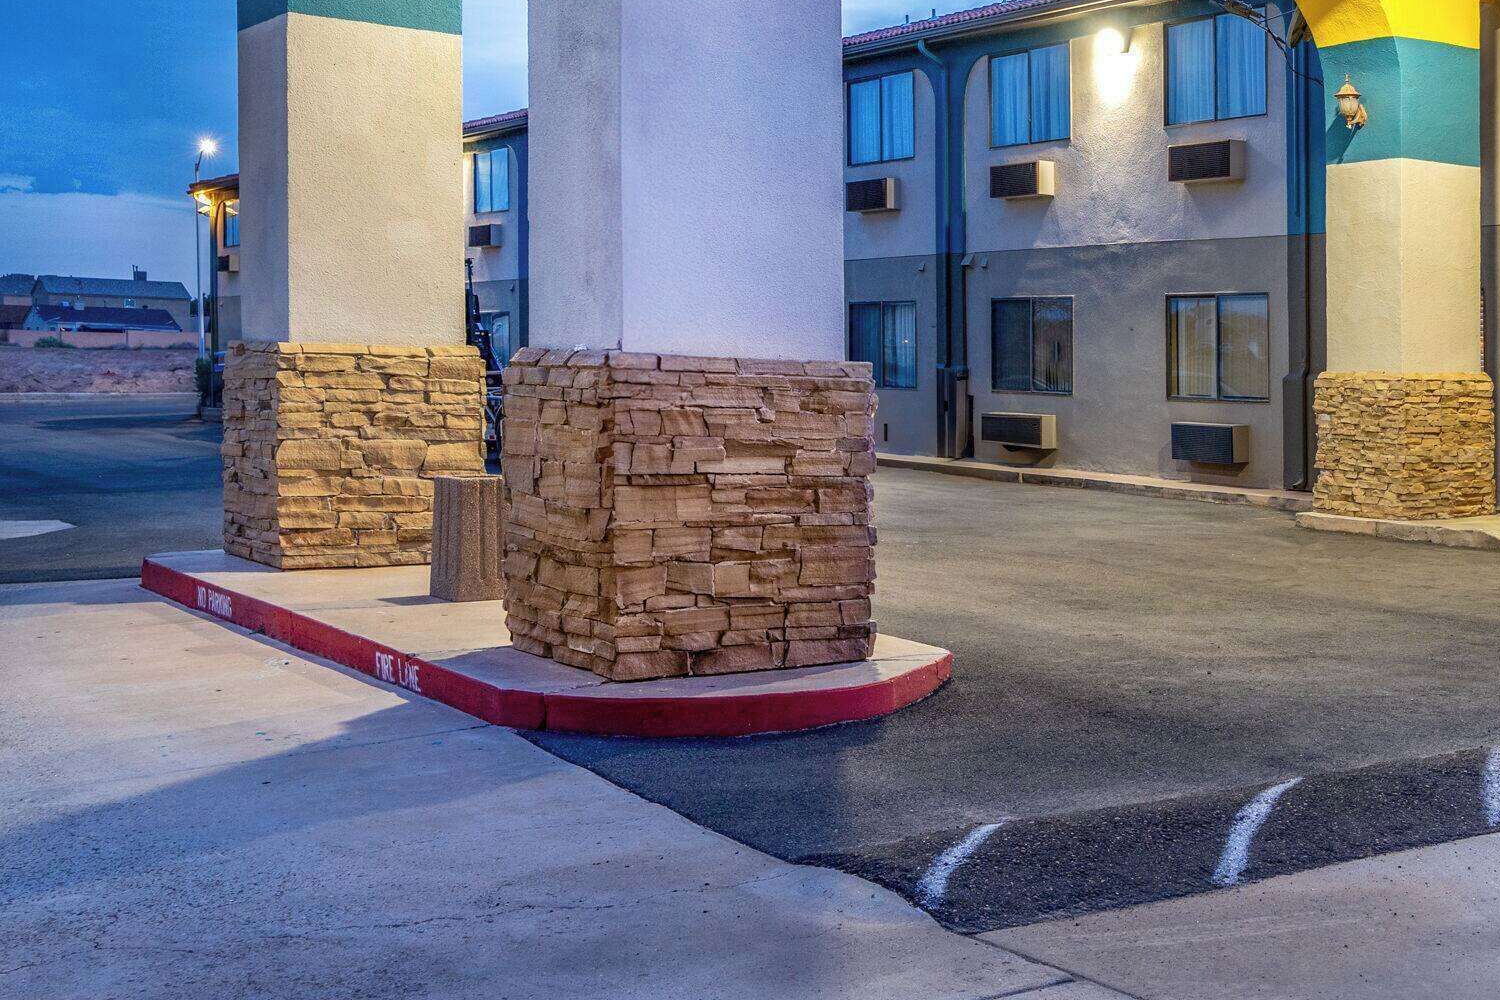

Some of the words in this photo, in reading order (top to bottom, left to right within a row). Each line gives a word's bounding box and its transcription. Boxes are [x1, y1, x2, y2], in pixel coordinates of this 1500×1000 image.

[197, 585, 206, 609] NO
[208, 588, 232, 618] PARKING
[375, 651, 395, 683] FIRE
[397, 657, 421, 692] LANE
